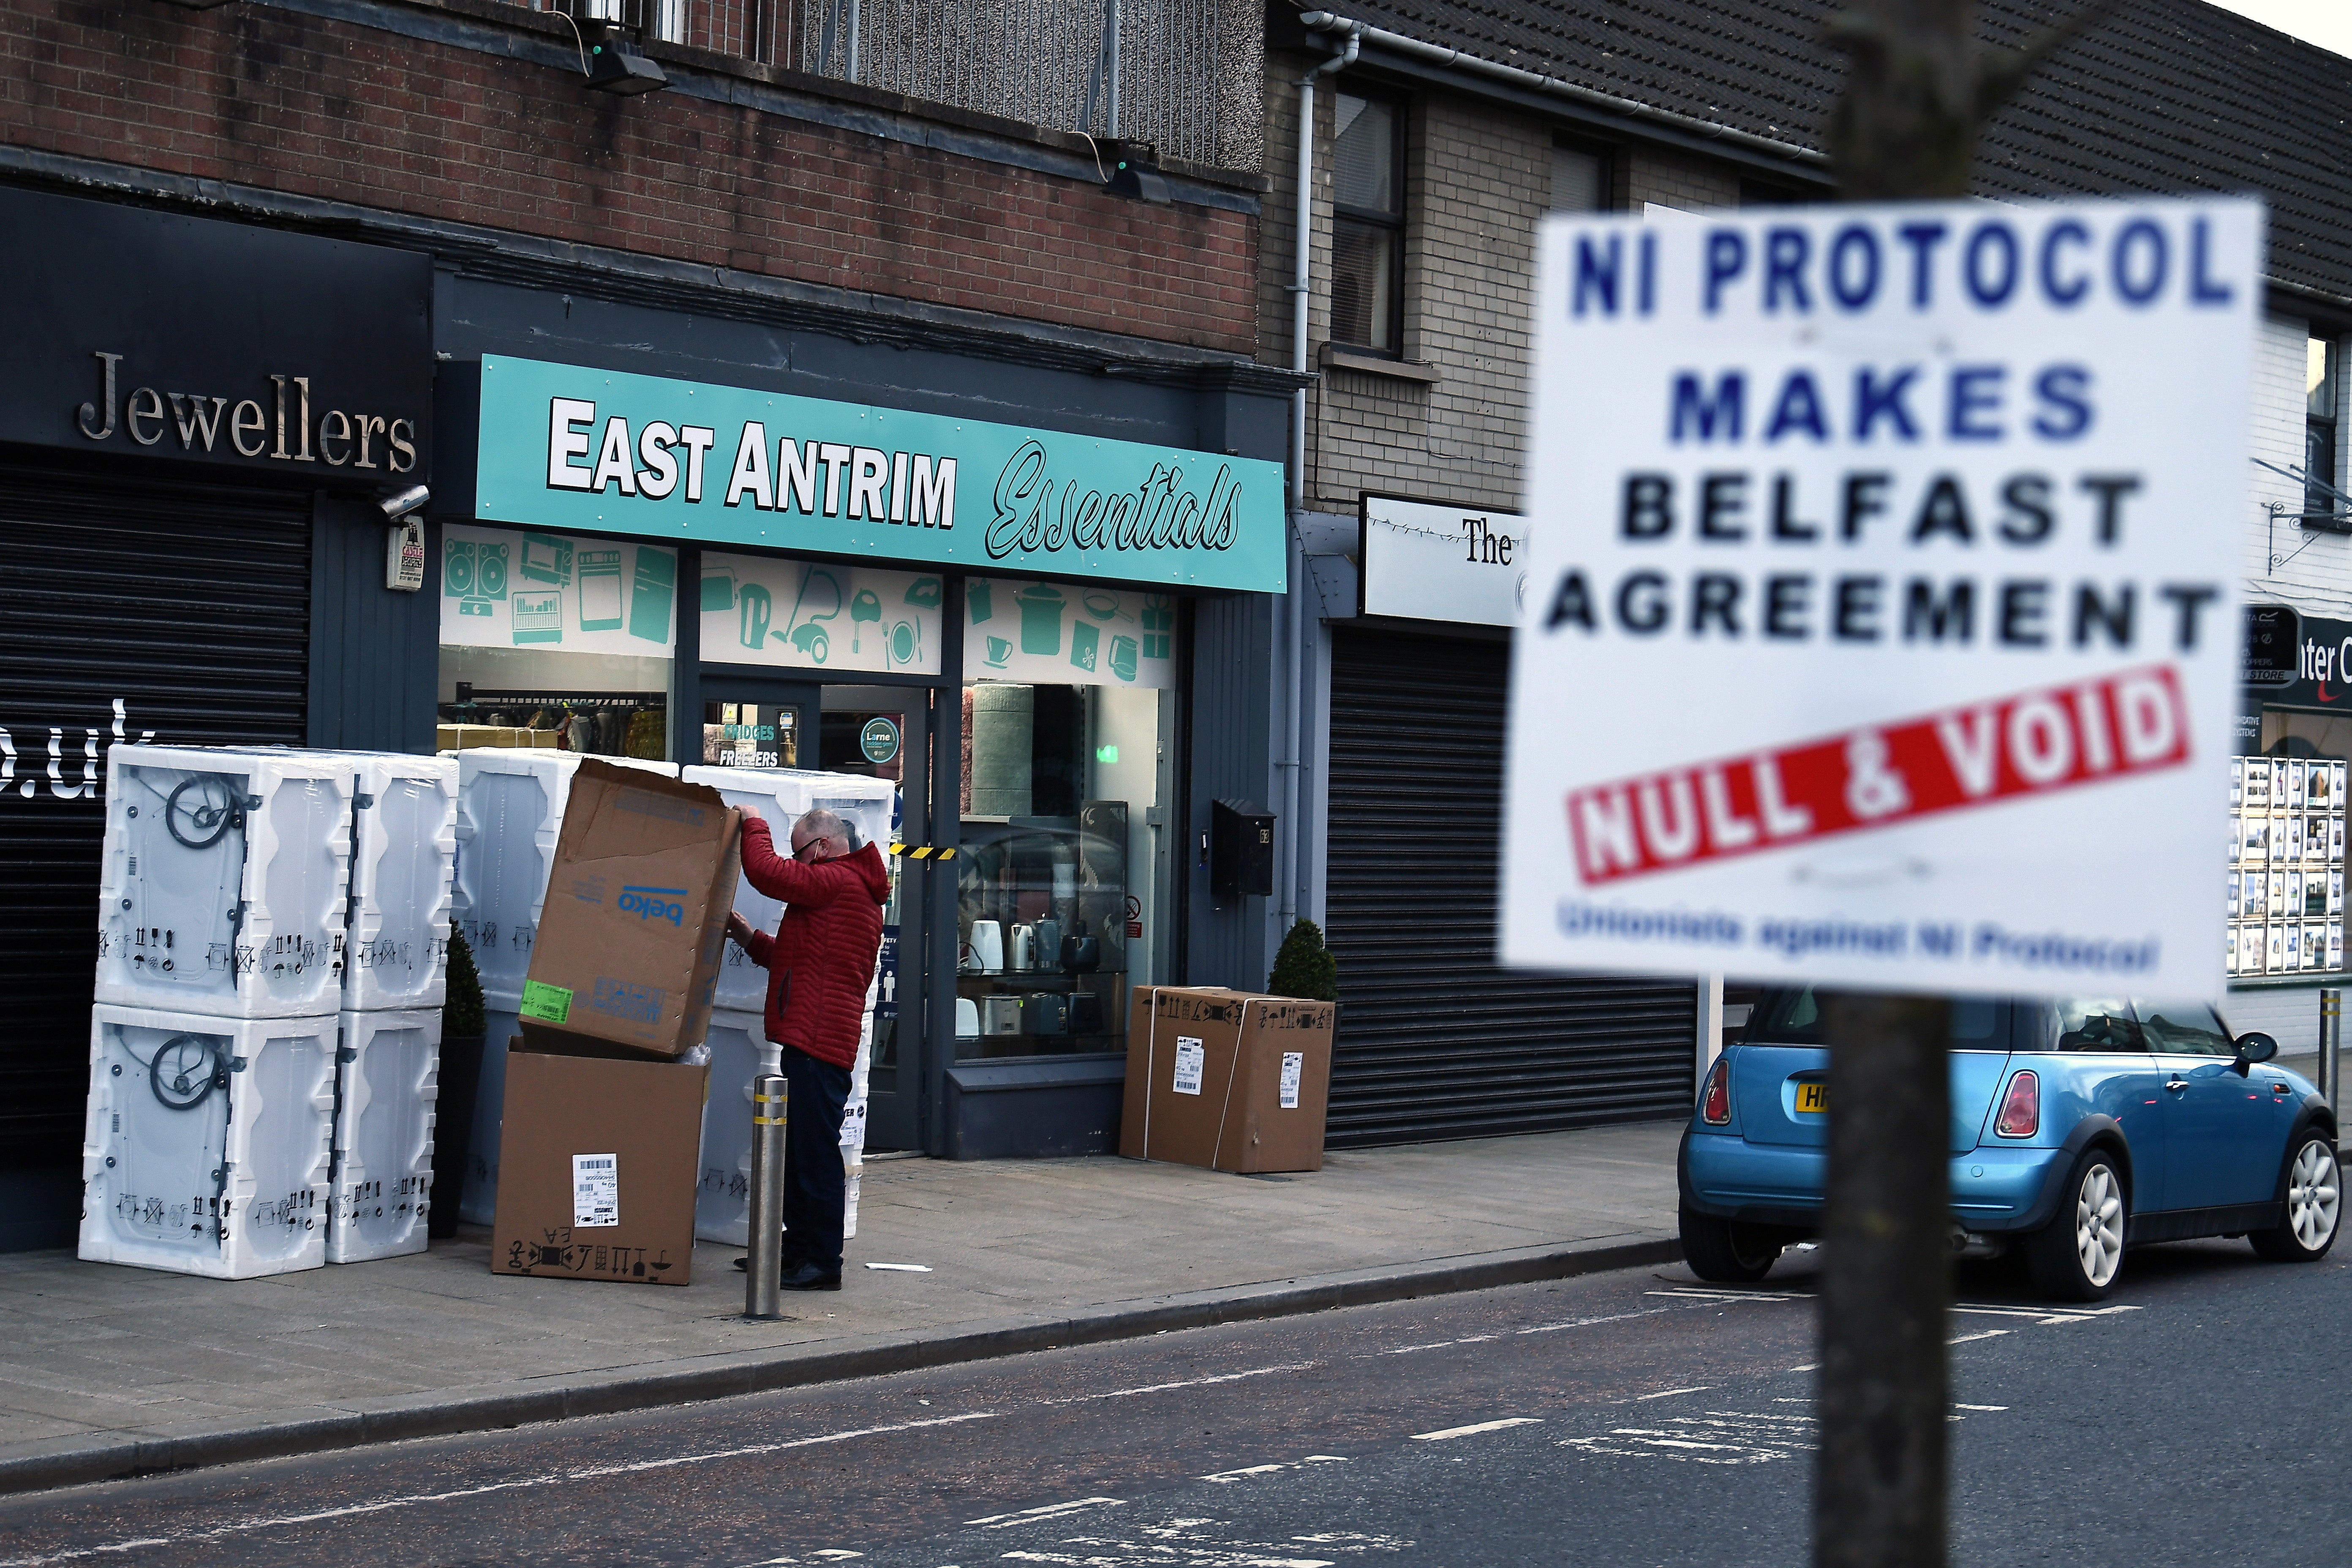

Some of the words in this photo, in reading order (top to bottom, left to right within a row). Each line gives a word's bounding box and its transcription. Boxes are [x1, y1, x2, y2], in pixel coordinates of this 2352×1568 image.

[1571, 232, 1658, 318] NI
[1702, 217, 2235, 316] PROTOCOL
[79, 351, 416, 473] Jewellers
[1667, 364, 2095, 445] MAKES
[547, 397, 714, 501] EAST
[724, 421, 958, 529] ANTRIM
[984, 440, 1242, 560] Essentials
[1619, 470, 2142, 547] BELFAST
[1462, 517, 1512, 566] The
[1544, 569, 2219, 652] AGREEMENT
[2250, 670, 2284, 679] STORE
[719, 750, 778, 767] FREEZERS
[724, 724, 775, 741] FRIDGES
[866, 732, 890, 741] Larne
[1578, 754, 1815, 876] NULL
[1845, 727, 1911, 819] &
[1935, 676, 2180, 797] VOID
[1260, 830, 1269, 842] 63
[618, 892, 684, 926] beko
[1558, 899, 1744, 946] Unionists
[1761, 912, 1898, 959] against
[1915, 924, 1956, 956] NI
[1973, 923, 2156, 973] Protocol
